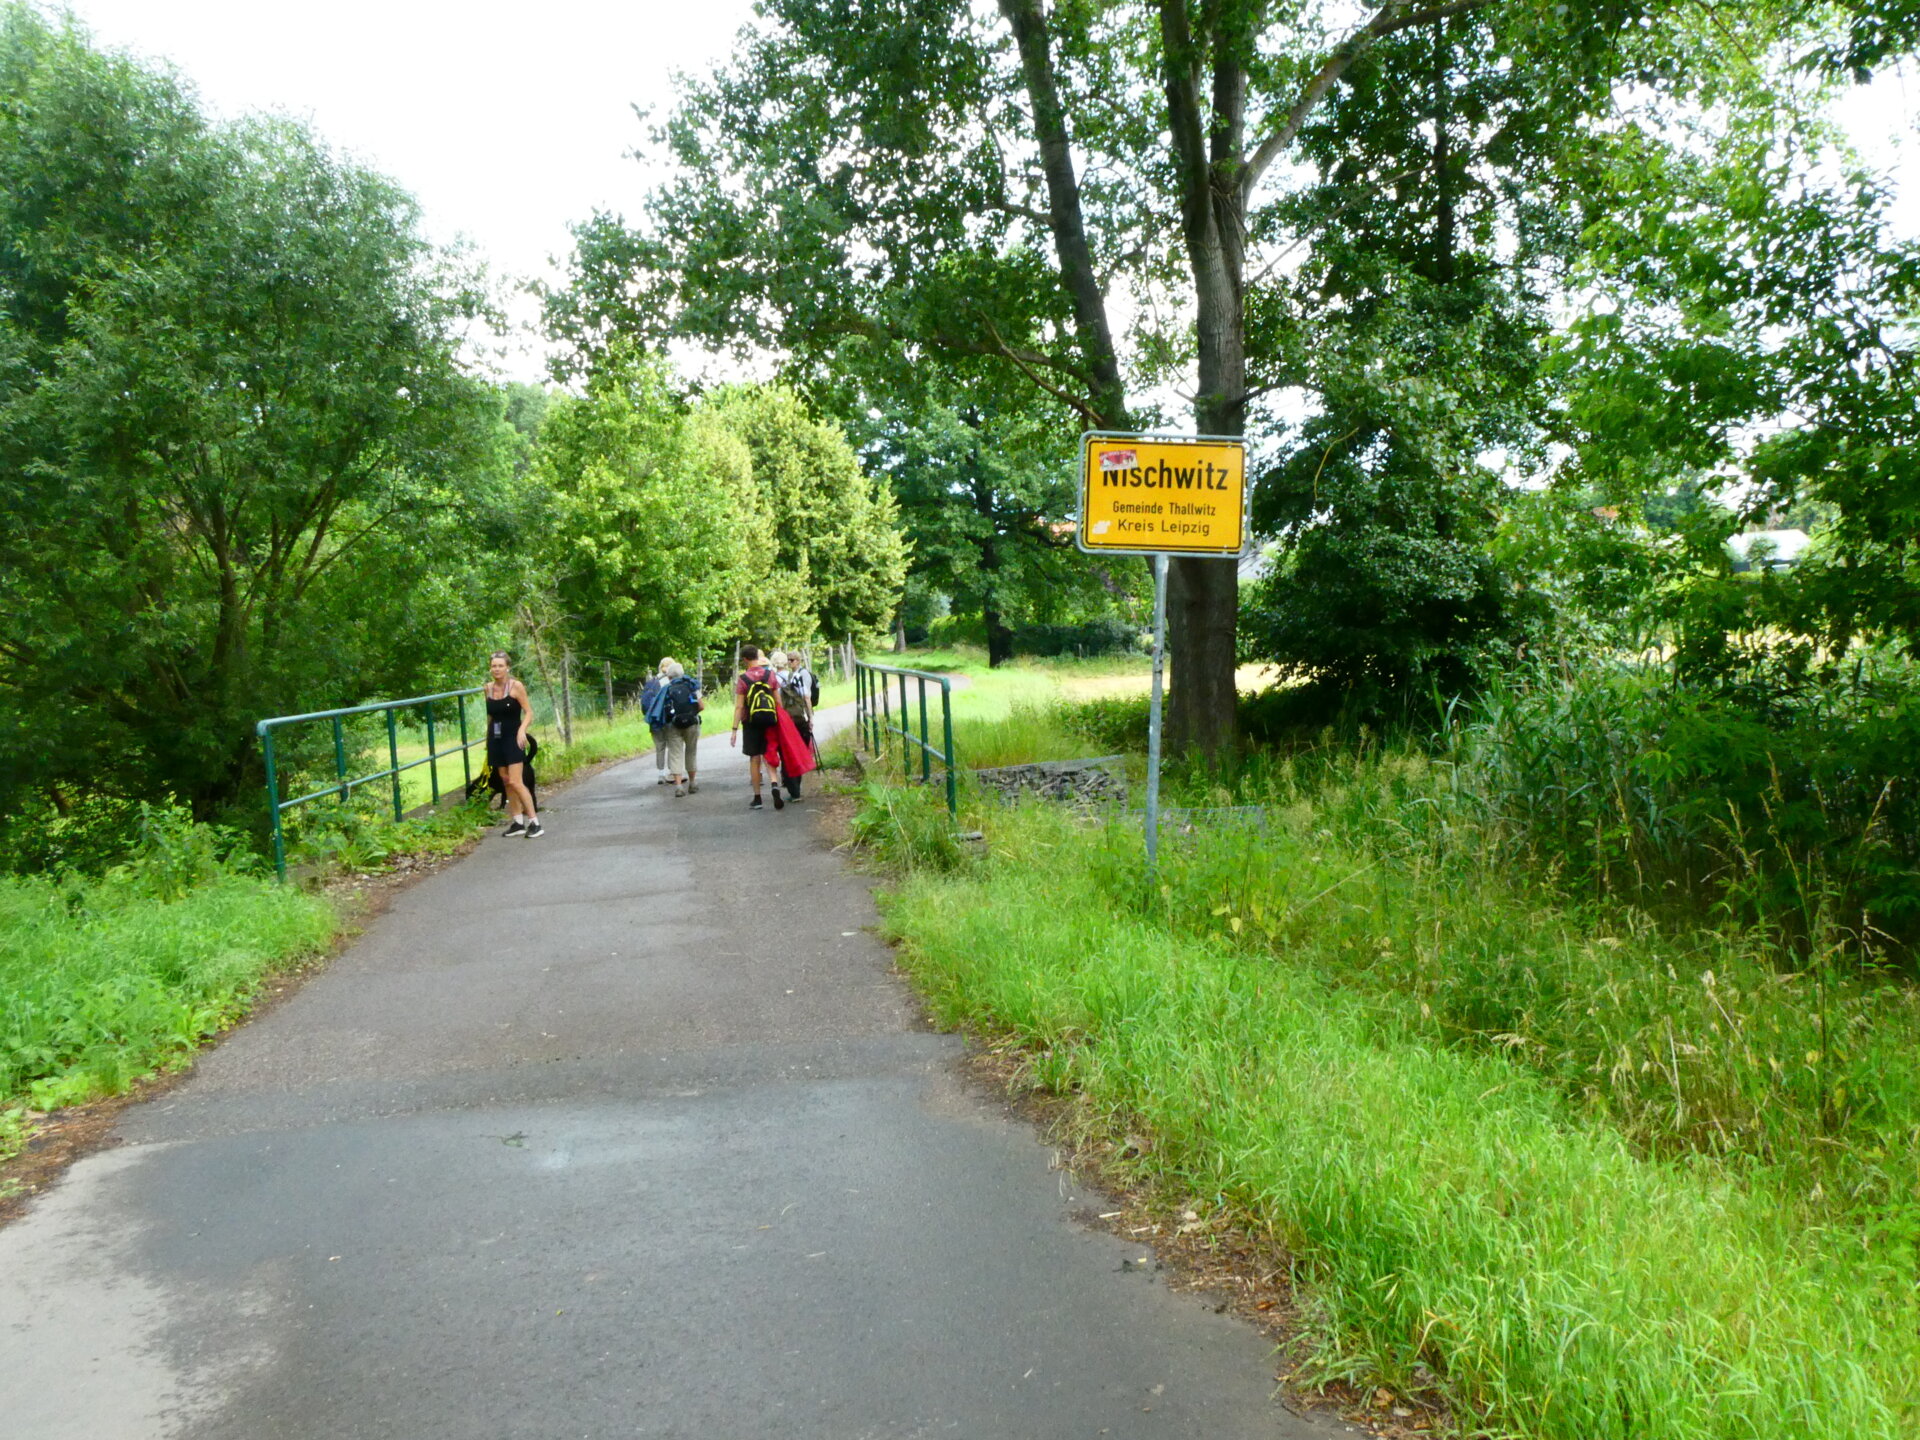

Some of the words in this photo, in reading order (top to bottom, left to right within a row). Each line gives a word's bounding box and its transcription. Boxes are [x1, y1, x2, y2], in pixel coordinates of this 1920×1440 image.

[1113, 501, 1163, 515] Gemeinde
[1169, 502, 1216, 516] Thallwitz
[1118, 518, 1154, 532] Kreis
[1161, 520, 1210, 537] Leipzig
